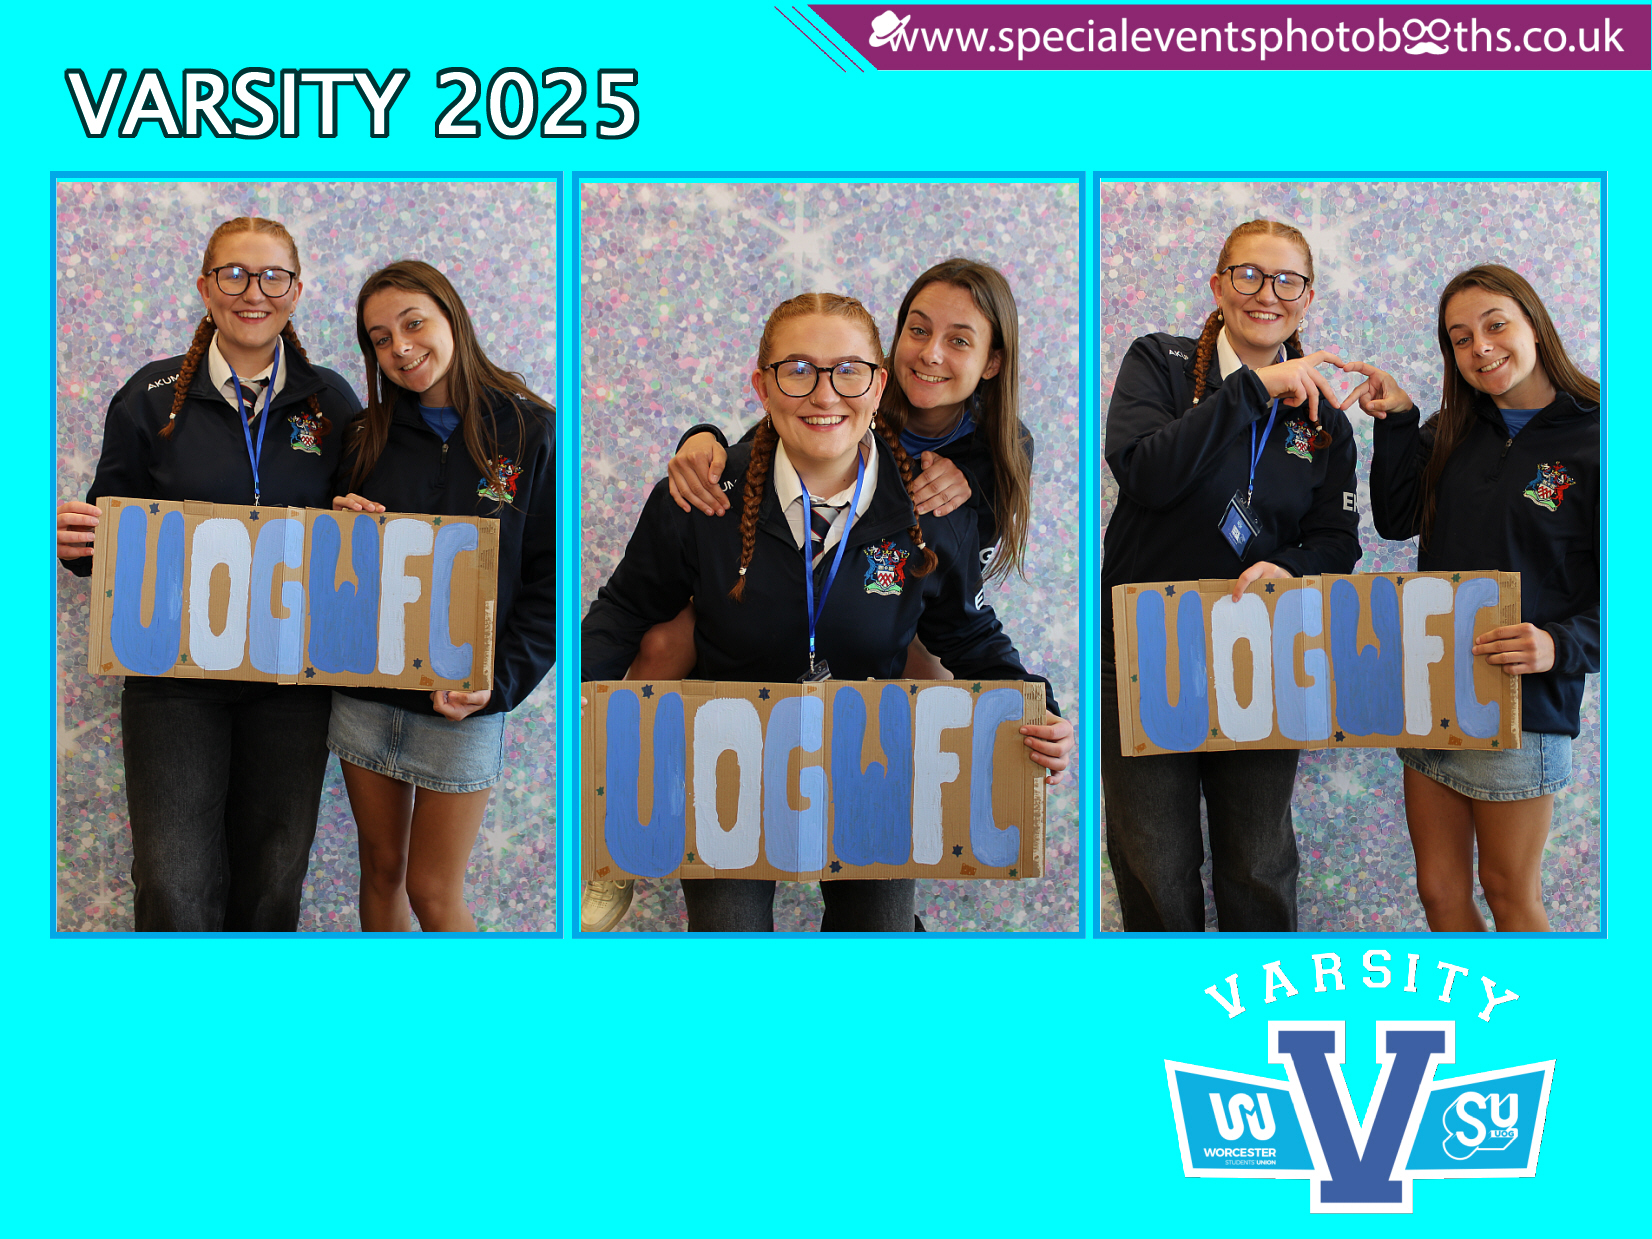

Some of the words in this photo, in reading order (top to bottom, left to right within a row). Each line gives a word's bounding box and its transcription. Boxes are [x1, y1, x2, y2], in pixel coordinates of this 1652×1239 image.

[110, 504, 479, 680] UOGWFC
[1136, 575, 1500, 752] UOGWFC
[604, 683, 1024, 878] UOGWFC
